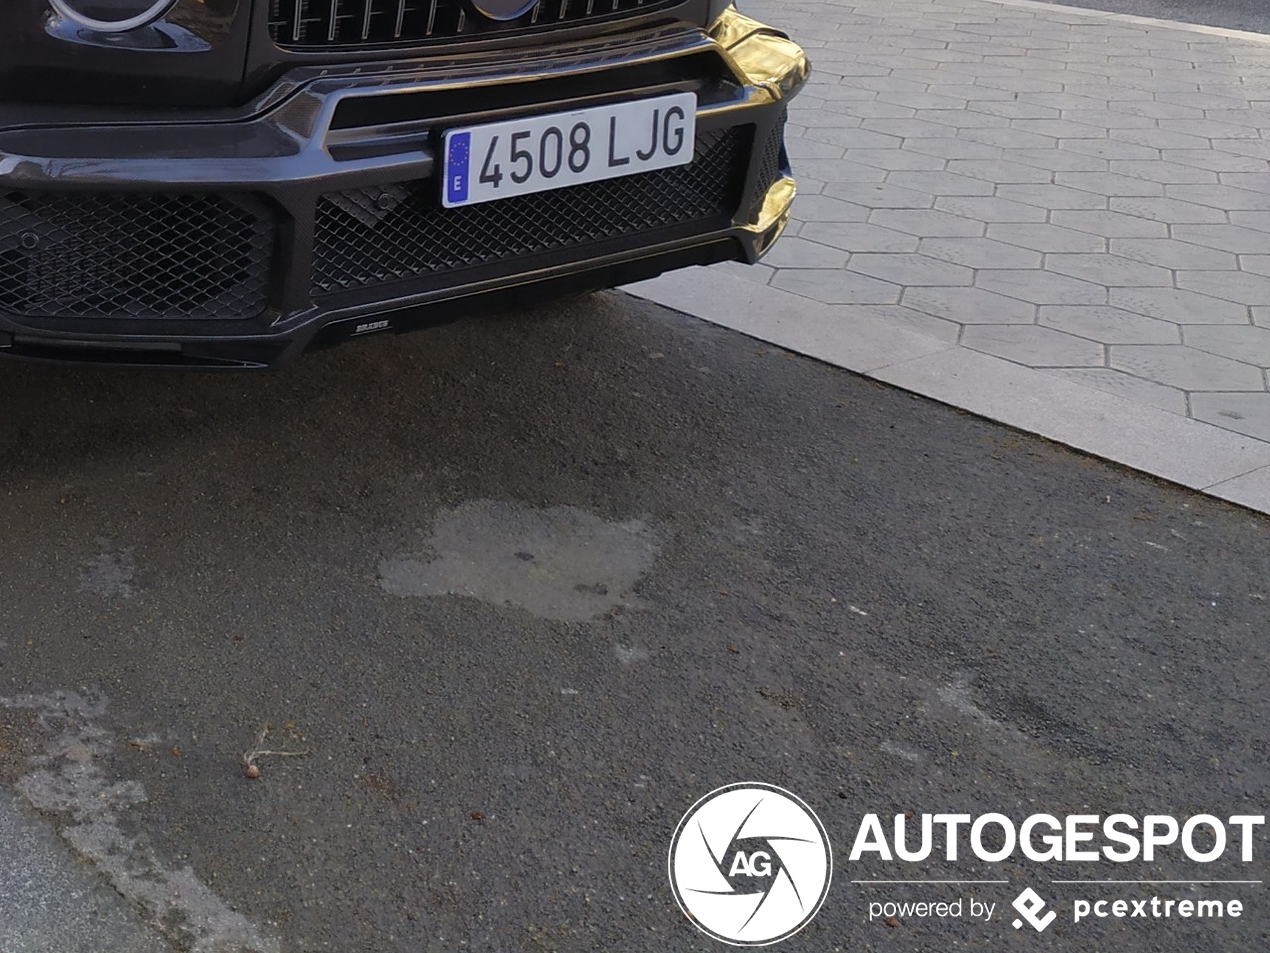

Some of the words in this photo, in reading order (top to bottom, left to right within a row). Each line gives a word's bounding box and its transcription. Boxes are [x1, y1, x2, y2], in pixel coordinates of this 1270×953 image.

[479, 121, 591, 189] 4508
[608, 105, 685, 168] LJG
[453, 175, 462, 191] E
